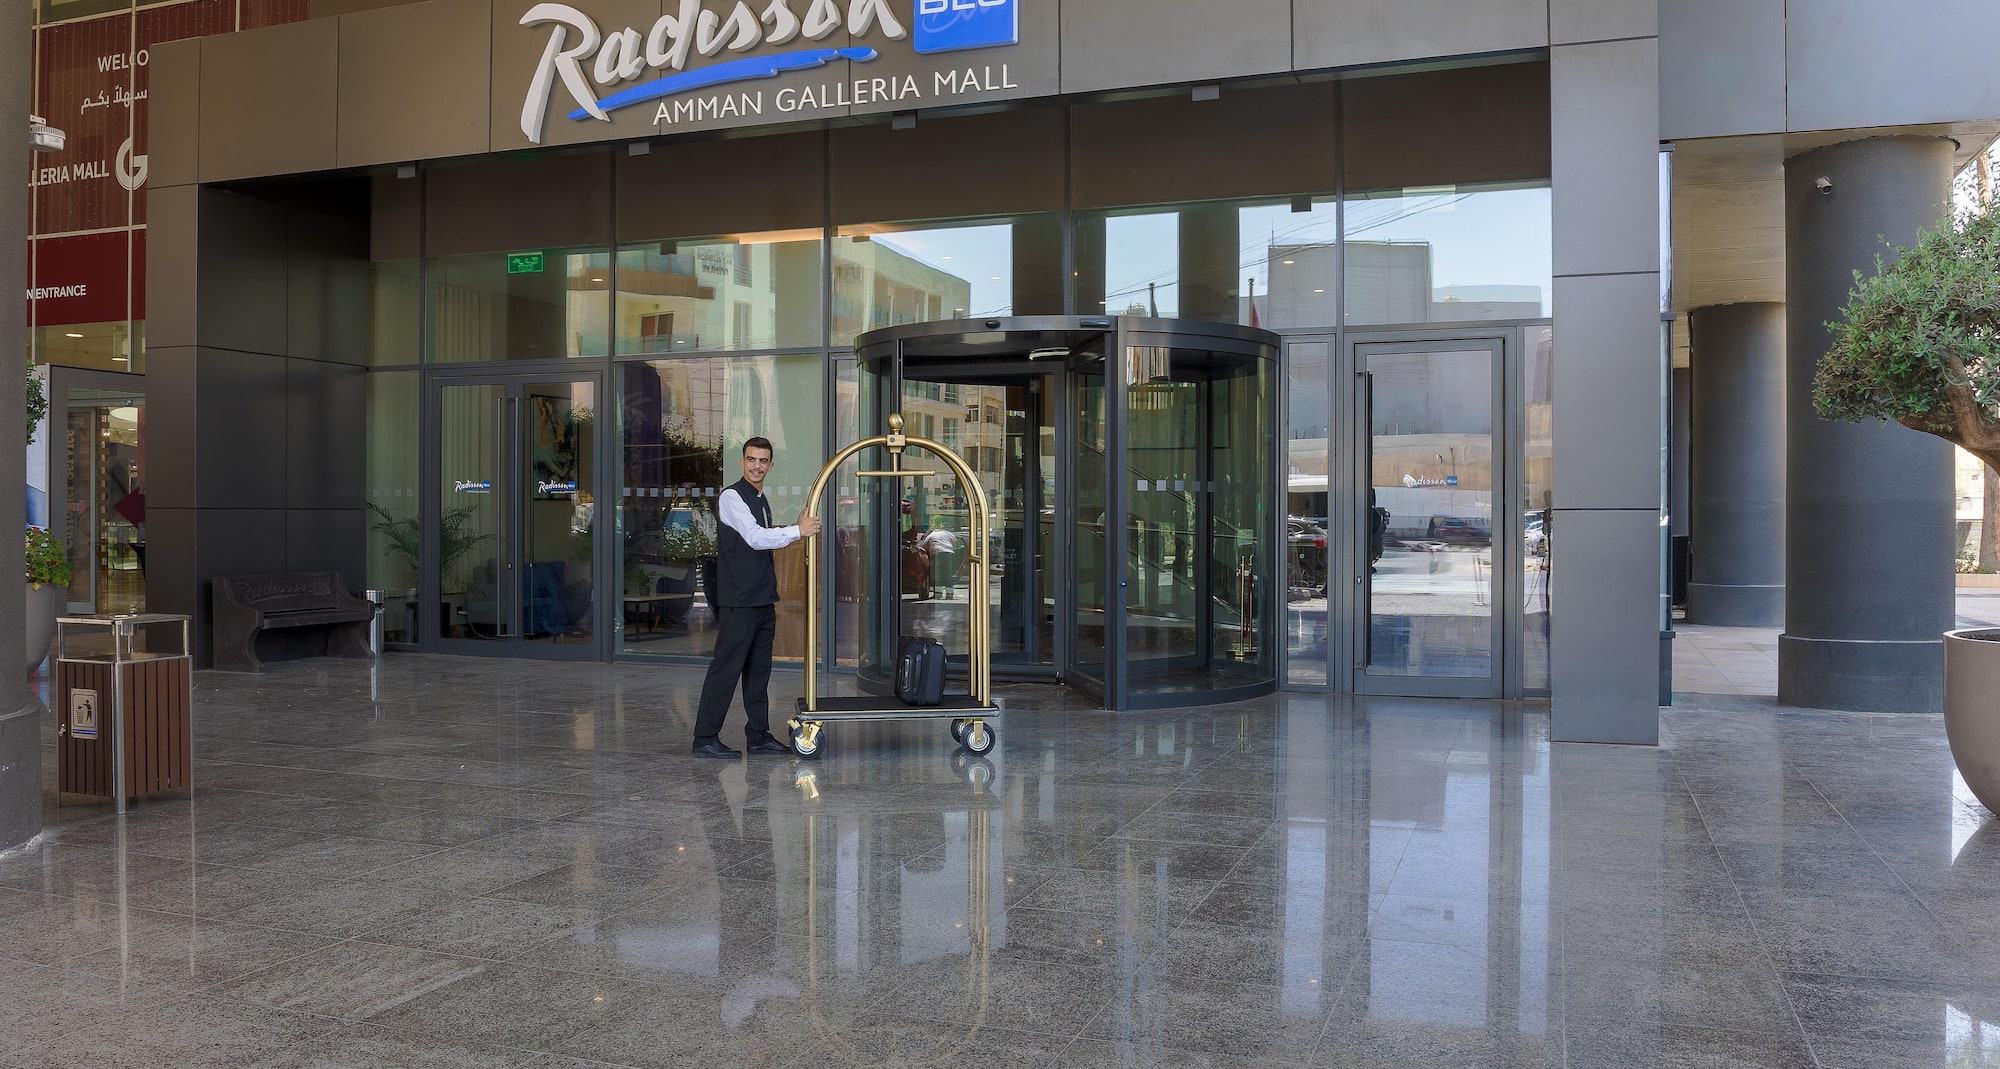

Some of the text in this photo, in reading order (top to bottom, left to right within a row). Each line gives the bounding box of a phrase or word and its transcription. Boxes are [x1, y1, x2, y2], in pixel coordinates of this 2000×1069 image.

[519, 0, 907, 144] Radisson
[652, 63, 1018, 126] AMMAN GALLERIA MALL
[28, 159, 110, 187] LERIA MALL
[35, 284, 87, 300] ENTRANCE
